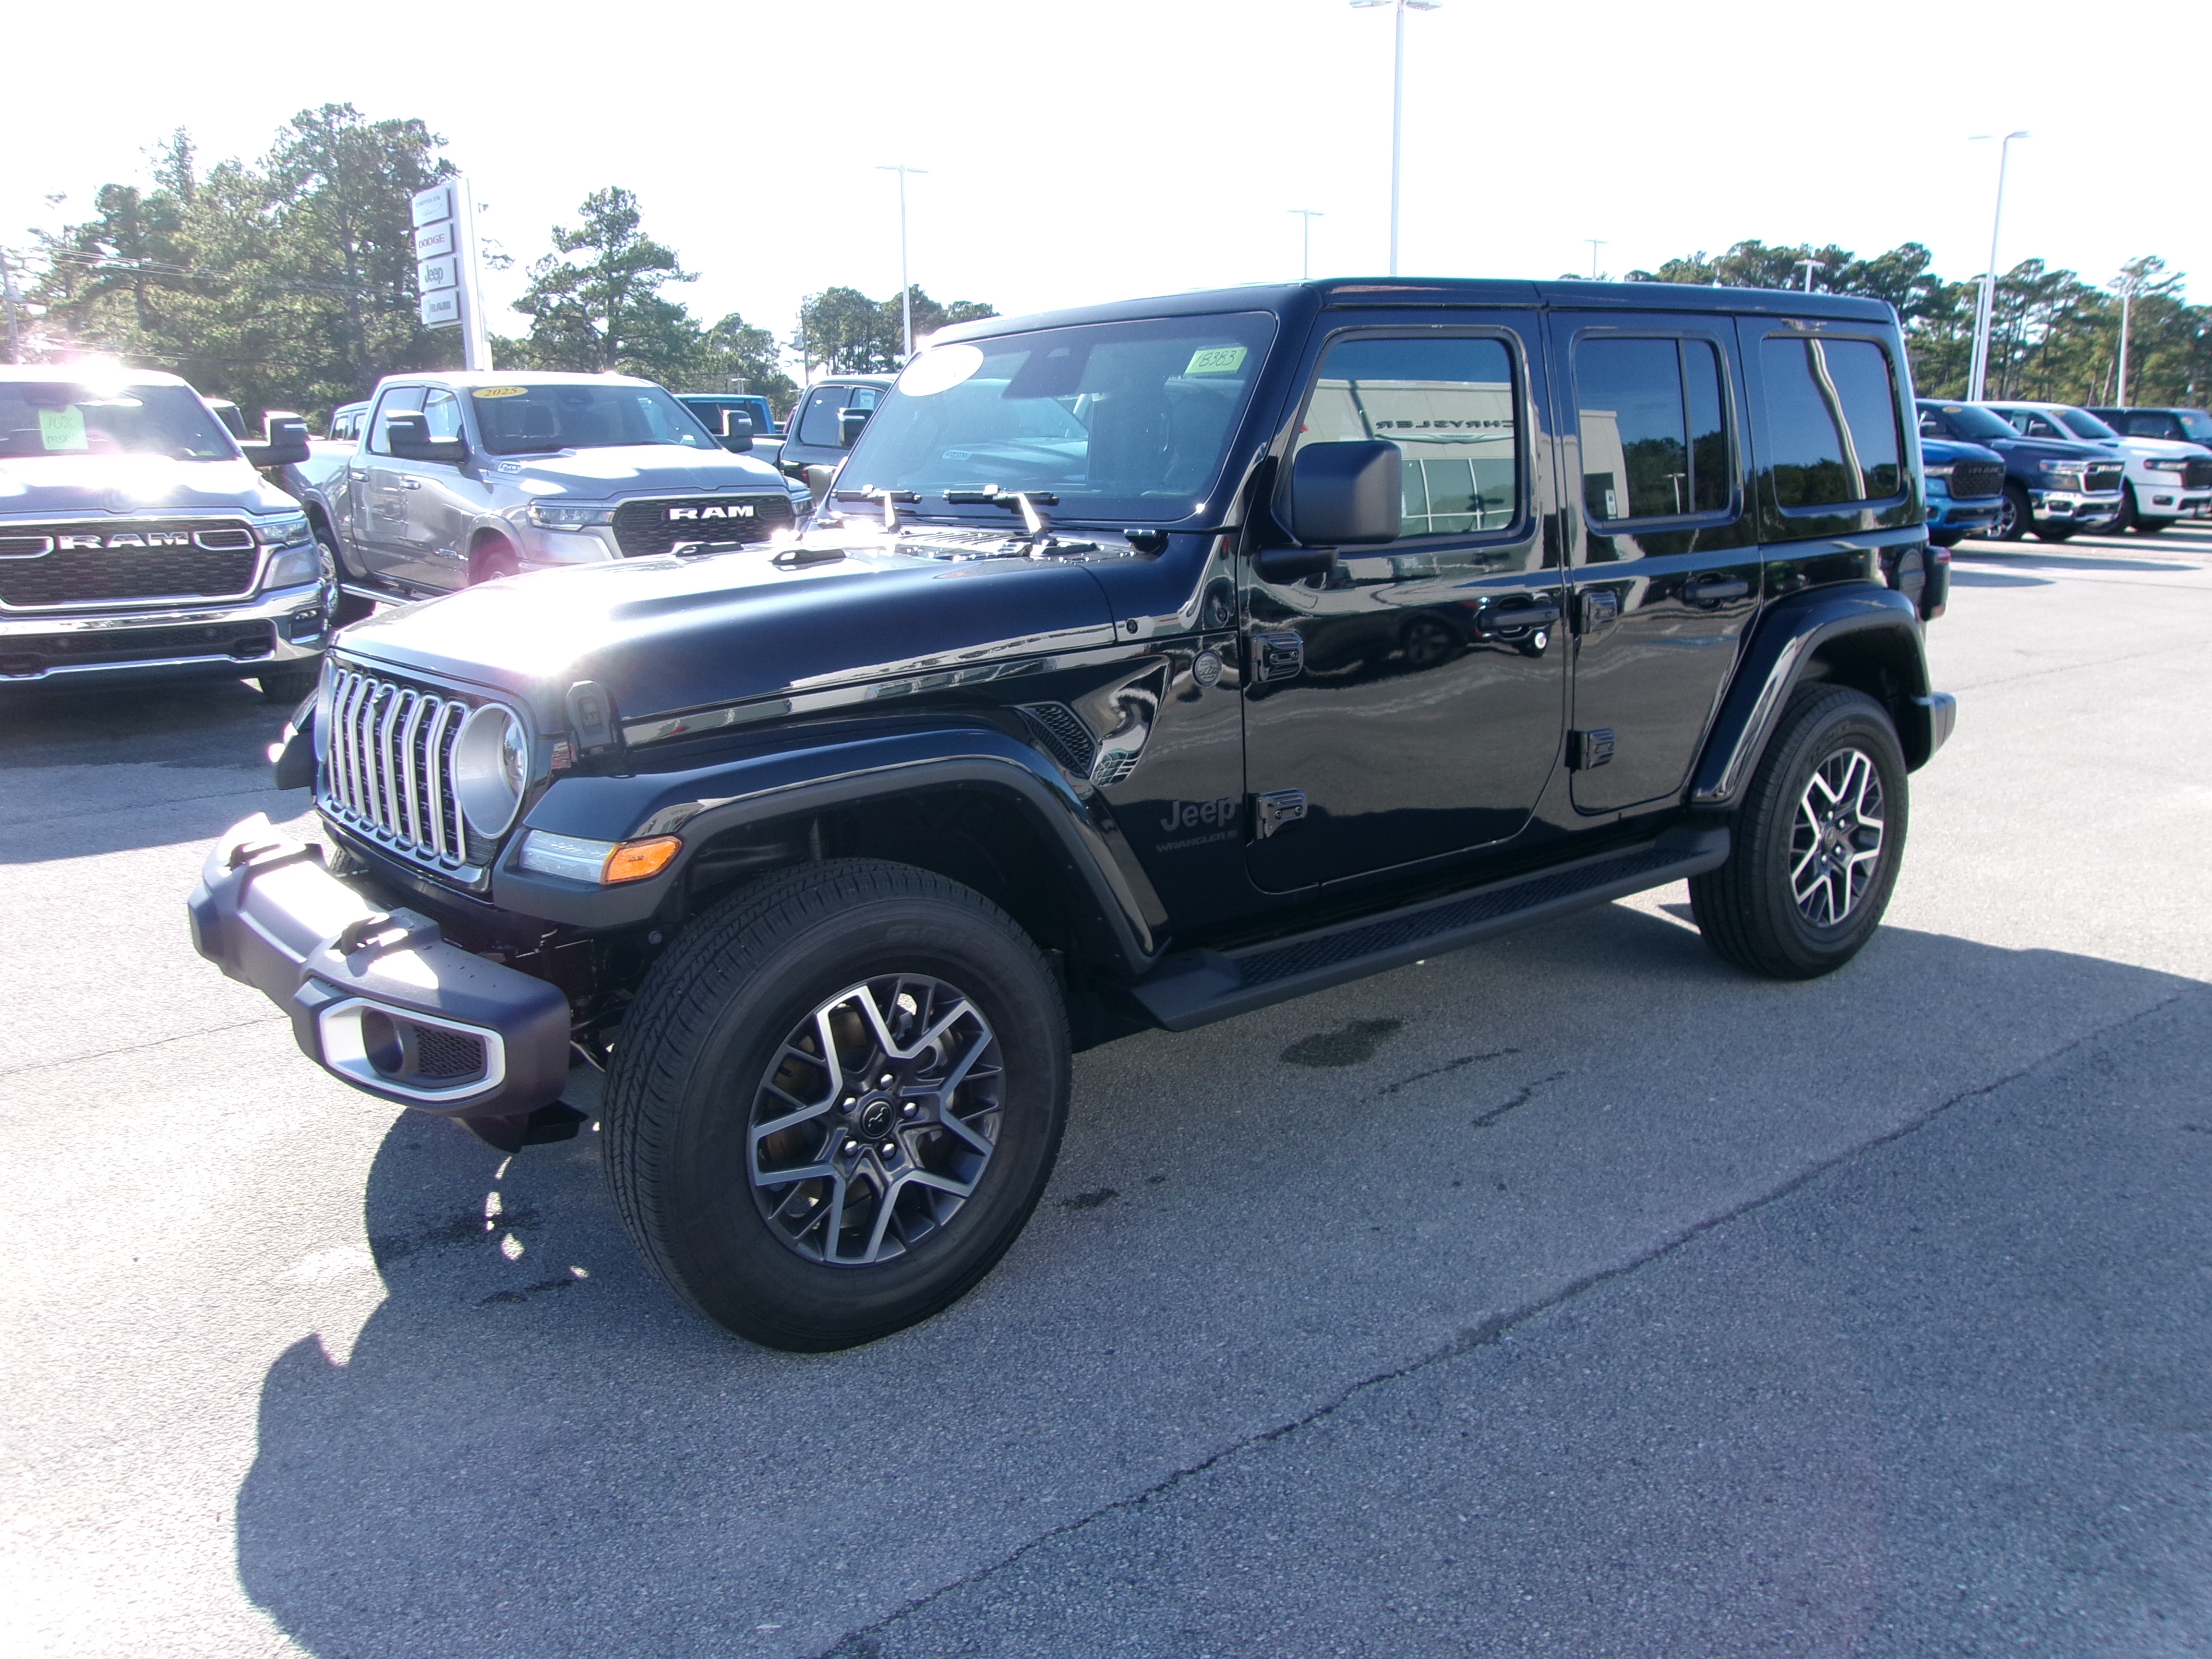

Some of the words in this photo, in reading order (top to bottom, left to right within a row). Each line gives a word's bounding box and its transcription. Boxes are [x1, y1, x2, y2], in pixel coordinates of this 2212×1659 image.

[419, 233, 445, 248] DODGE
[424, 264, 443, 284] Jeep
[1192, 350, 1237, 367] 18383
[484, 387, 518, 397] 2025
[49, 416, 73, 429] 10%
[670, 505, 754, 520] RAM
[60, 531, 189, 549] RAM
[1160, 798, 1236, 831] Jeep
[1155, 832, 1226, 852] WRANGLER
